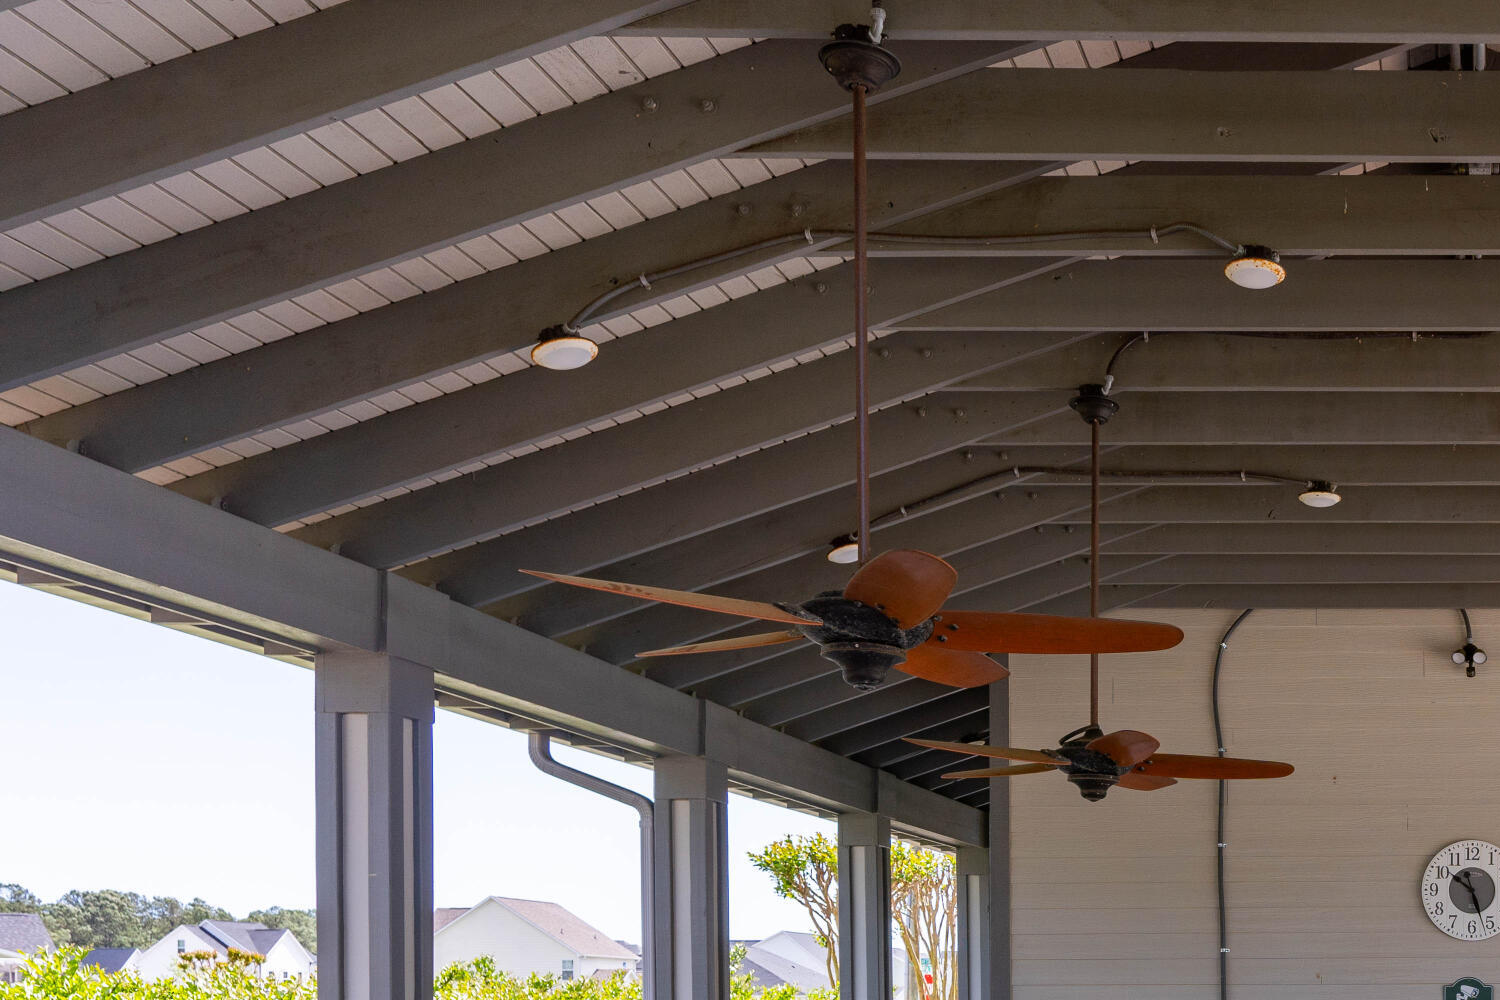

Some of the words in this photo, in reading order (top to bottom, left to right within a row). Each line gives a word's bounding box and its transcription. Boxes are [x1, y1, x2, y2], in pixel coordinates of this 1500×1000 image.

[1449, 853, 1460, 866] 11
[1465, 847, 1480, 860] 12
[1488, 852, 1494, 866] 1
[1436, 866, 1450, 879] 10
[1430, 883, 1438, 896] 9
[1434, 902, 1444, 916] 8
[1449, 914, 1458, 928] 7
[1468, 920, 1476, 934] 6
[1486, 916, 1494, 930] 5
